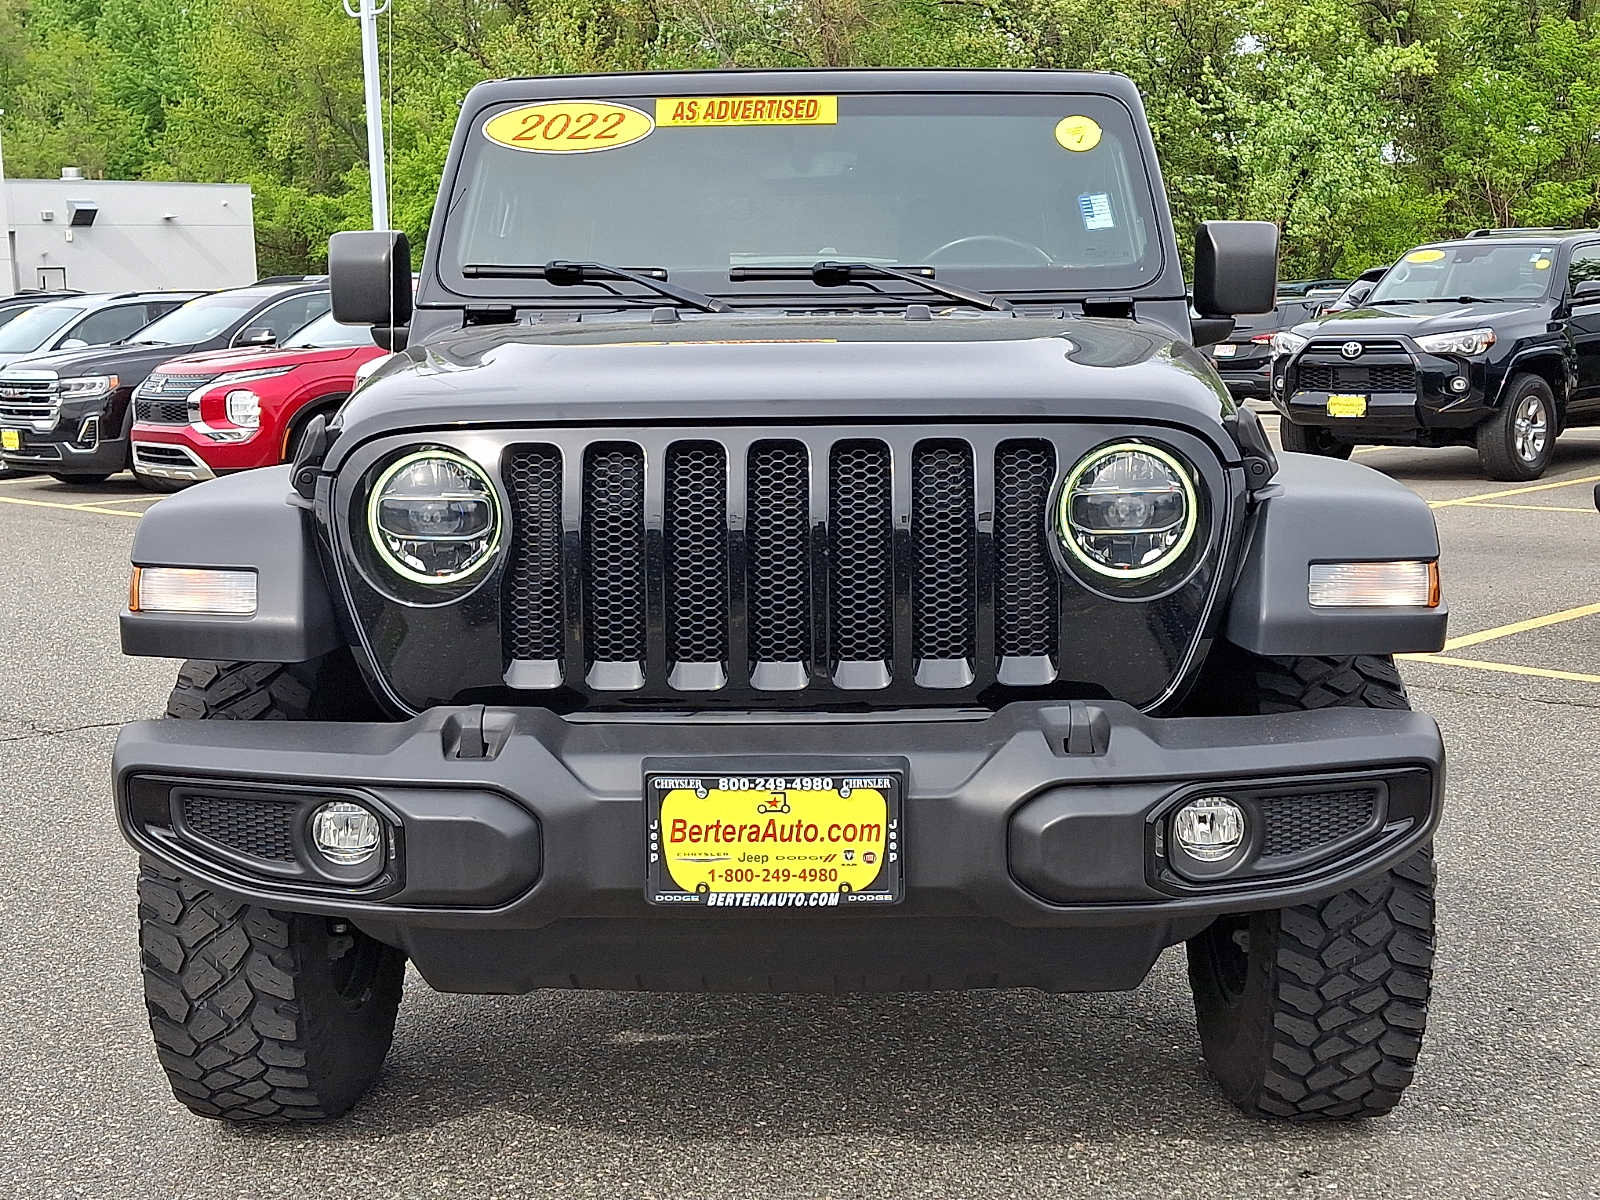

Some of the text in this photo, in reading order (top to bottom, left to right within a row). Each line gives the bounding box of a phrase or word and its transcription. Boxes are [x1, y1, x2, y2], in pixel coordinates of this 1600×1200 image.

[672, 99, 818, 121] AS ADVERTISED
[512, 112, 626, 141] 2022
[654, 779, 702, 789] CHRYSLER
[718, 778, 833, 791] 800-249-4980
[842, 778, 891, 789] CHRYSLER
[670, 818, 881, 844] BerteraAuto.com
[650, 819, 659, 863] Jeep
[889, 819, 898, 863] Jeep
[737, 852, 769, 864] Jeep
[708, 868, 838, 883] 1-800-249-4980
[706, 893, 840, 907] BERTERAAUTO.COM
